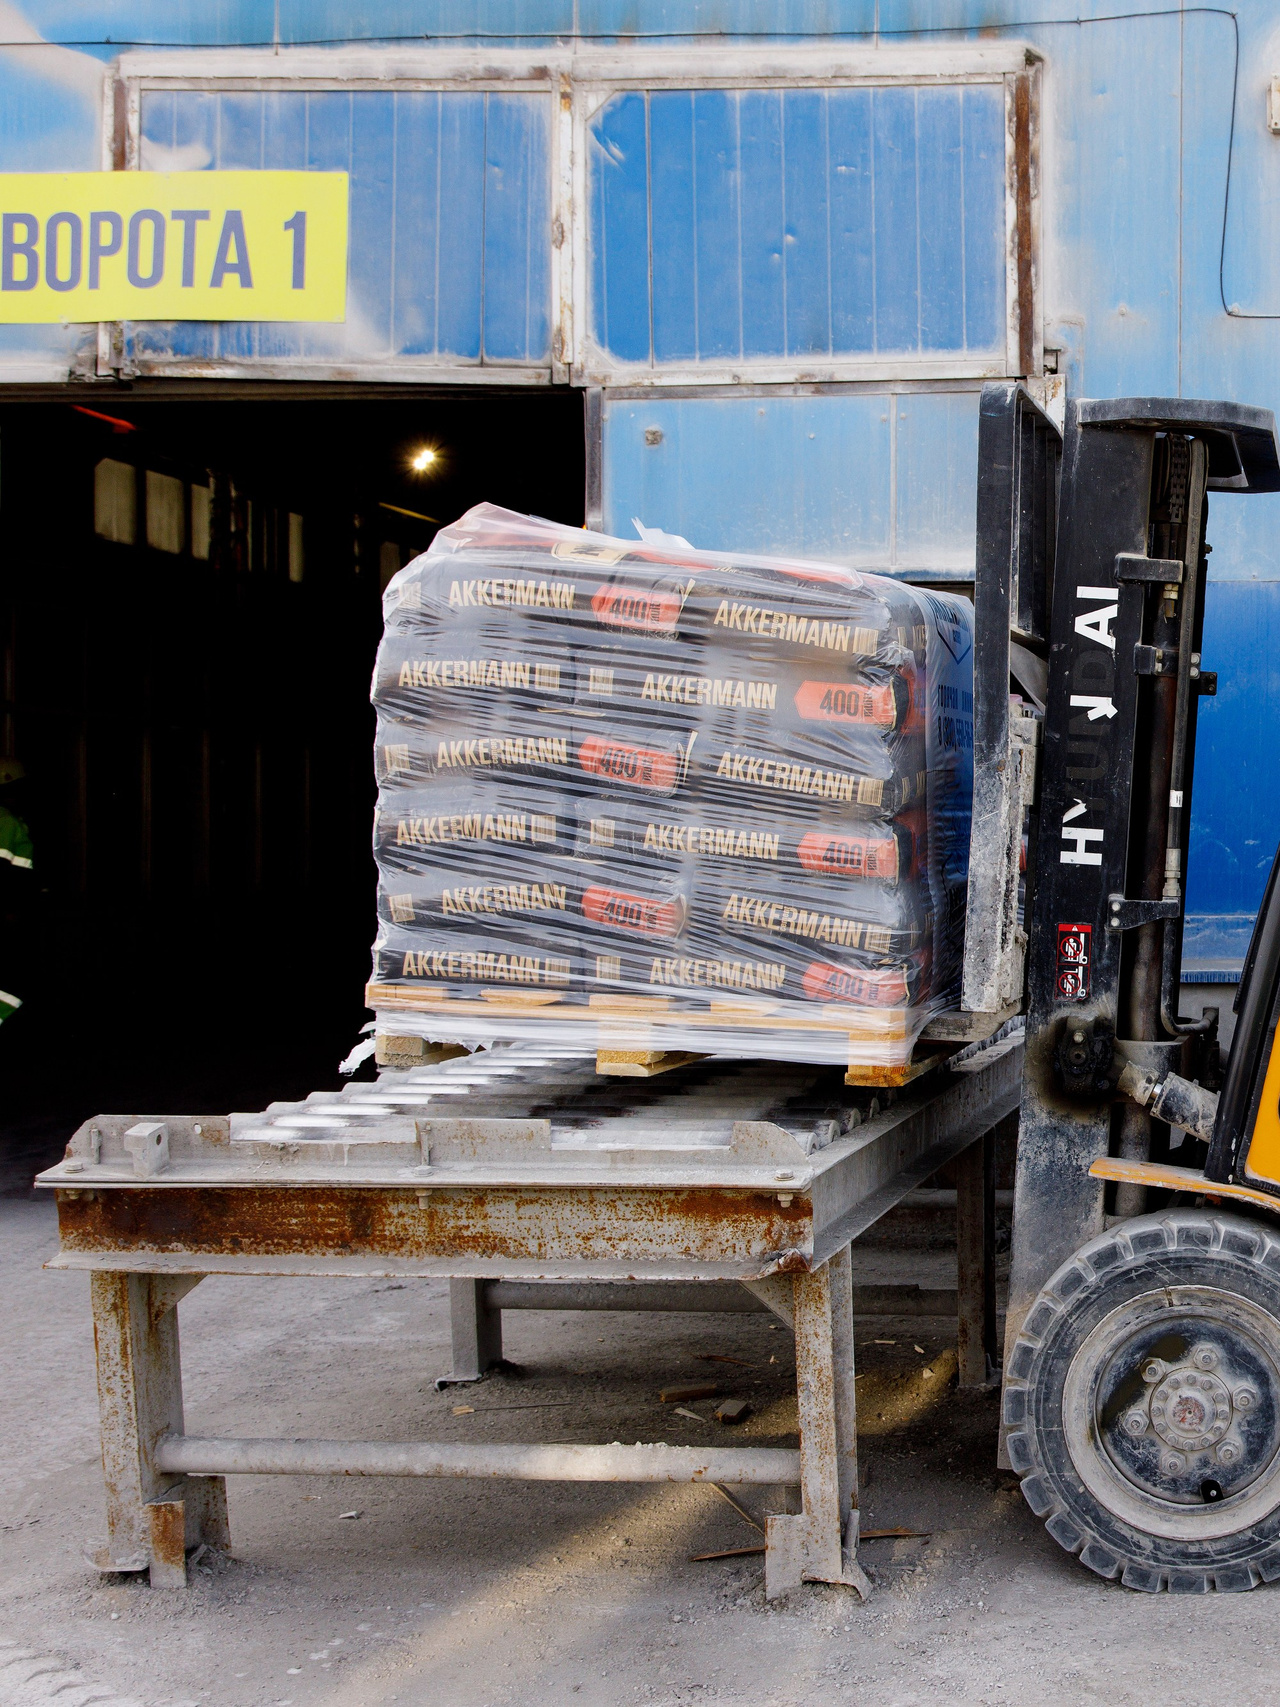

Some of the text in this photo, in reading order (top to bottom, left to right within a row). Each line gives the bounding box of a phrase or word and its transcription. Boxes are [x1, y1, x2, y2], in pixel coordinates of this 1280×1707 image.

[1, 209, 308, 292] ВОРОТА 1
[450, 579, 576, 610] AKKERMANN
[608, 594, 648, 623] 400
[714, 600, 851, 652] AKKERMANN
[398, 660, 530, 689] AKKERMANN
[640, 673, 778, 710] AKKERMANN
[819, 689, 860, 716] 400
[437, 738, 568, 768] AKKERMANN
[600, 747, 638, 778] 400
[716, 751, 855, 802] AKKERMANN
[396, 813, 526, 846] AKKERMANN
[643, 823, 780, 860] AKKERMANN
[821, 840, 862, 870] 400
[442, 884, 567, 915] AKKERMANN
[602, 898, 642, 927] 400
[722, 894, 864, 948] AKKERMANN
[402, 950, 540, 983] AKKERMANN
[650, 958, 786, 989] AKKERMANN
[822, 970, 864, 998] 400
